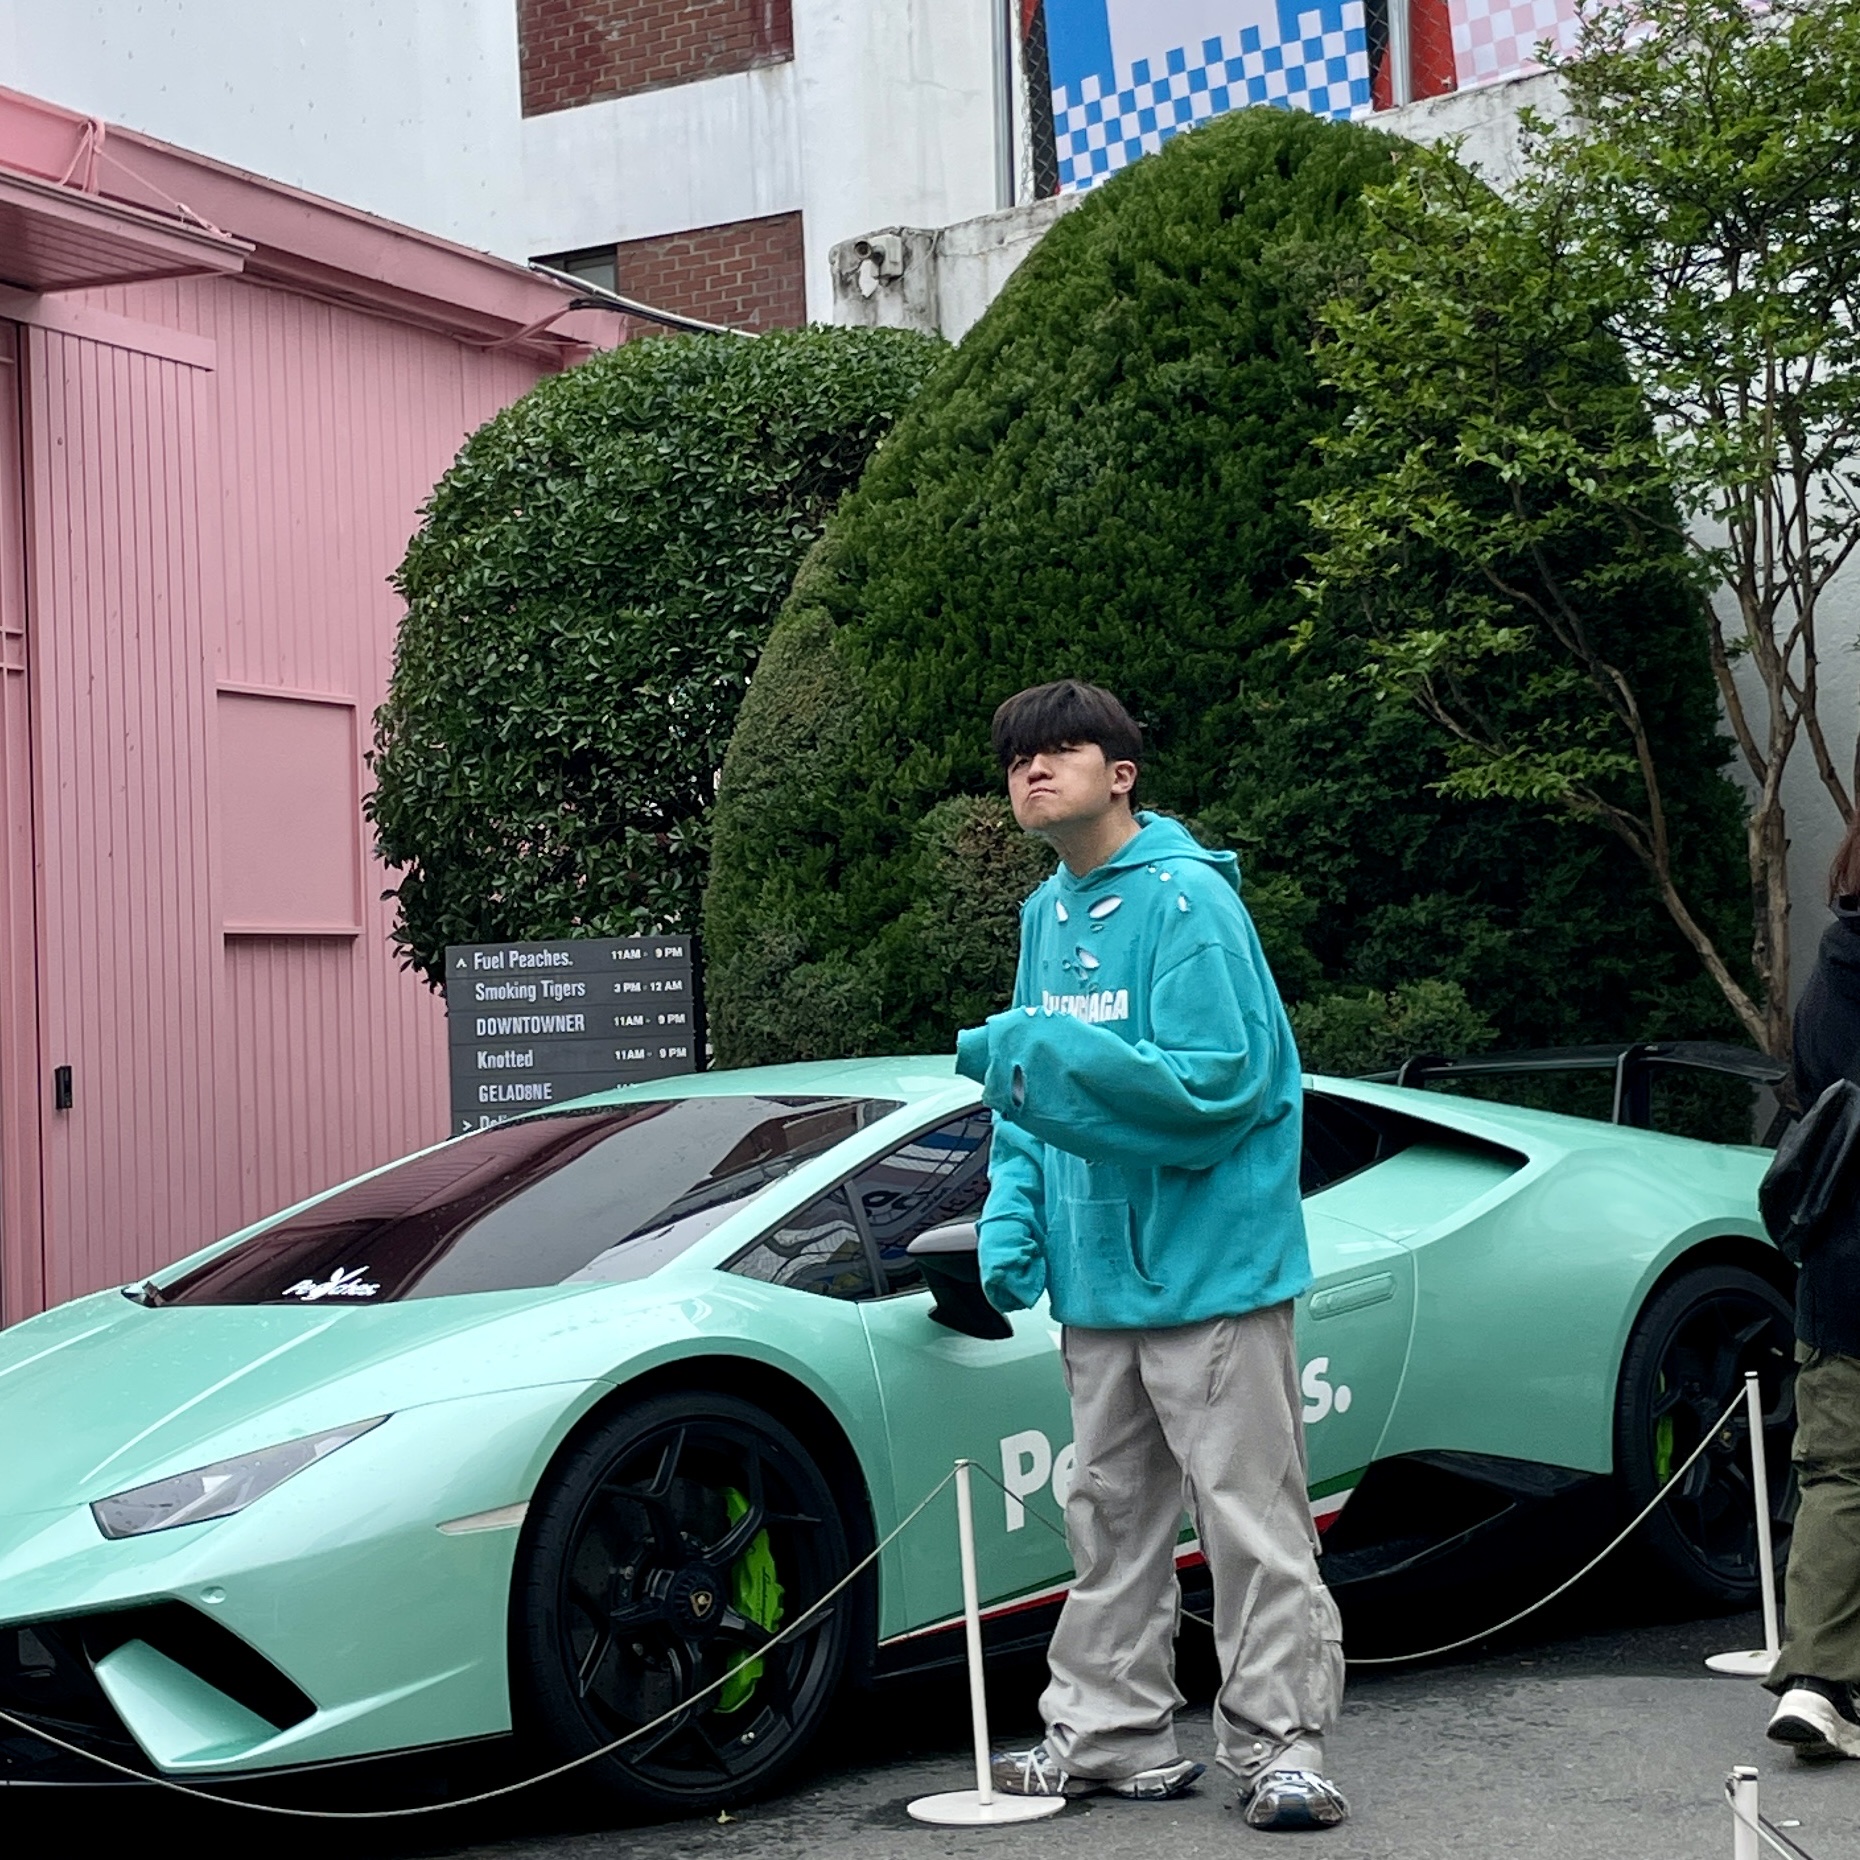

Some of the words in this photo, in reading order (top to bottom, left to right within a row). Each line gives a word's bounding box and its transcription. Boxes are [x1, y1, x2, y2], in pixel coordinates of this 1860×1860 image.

[474, 950, 505, 970] Fuel
[508, 948, 574, 969] Peaches.
[611, 948, 641, 960] 11AM
[664, 946, 683, 957] PM
[475, 981, 537, 1002] Smoking
[540, 979, 586, 1001] Tigers
[614, 983, 621, 993] 3
[623, 982, 641, 992] PM
[650, 981, 662, 991] 12
[664, 979, 683, 991] AM
[476, 1014, 586, 1037] DOWNTOWNER
[614, 1014, 644, 1026] 11AM
[667, 1013, 686, 1024] PM
[477, 1050, 534, 1070] Knotted
[615, 1048, 645, 1060] 11AM
[668, 1047, 687, 1058] PM
